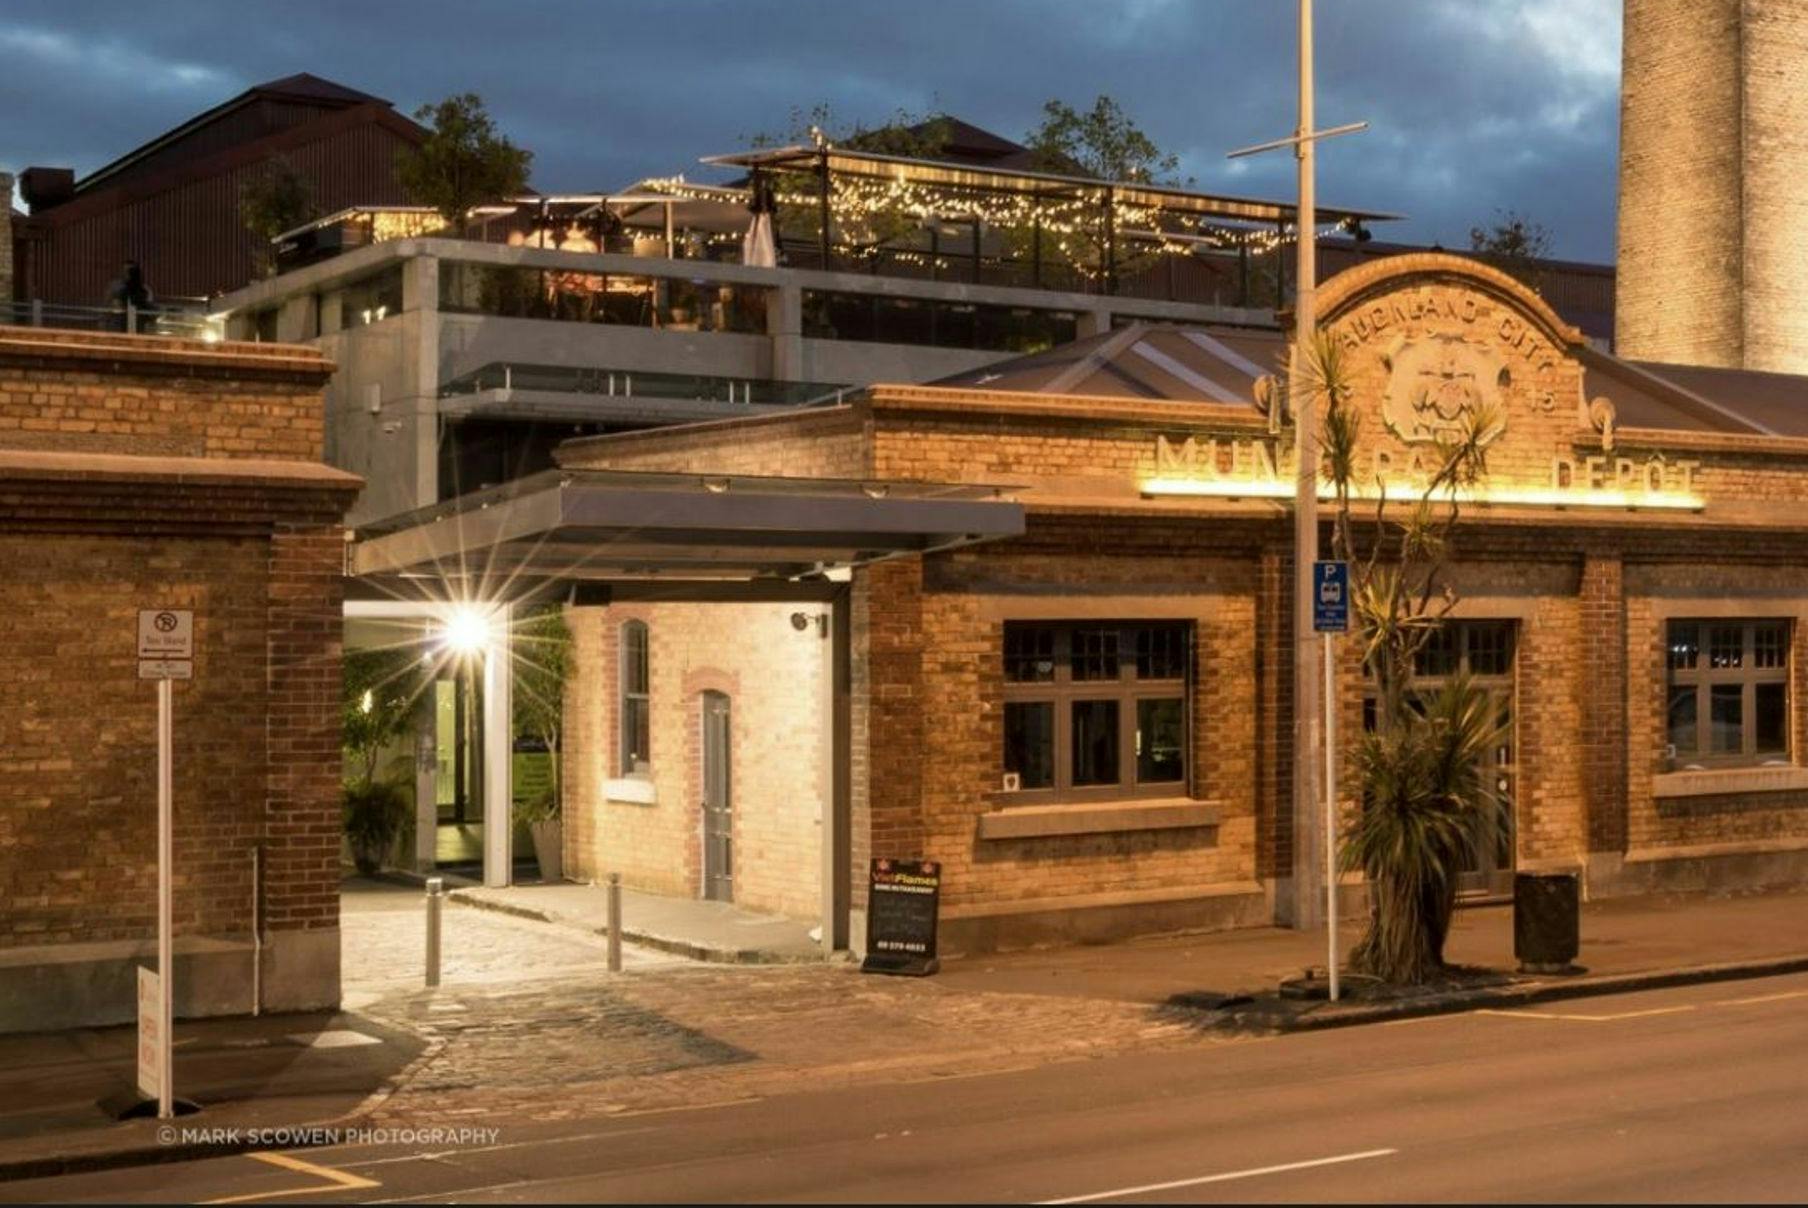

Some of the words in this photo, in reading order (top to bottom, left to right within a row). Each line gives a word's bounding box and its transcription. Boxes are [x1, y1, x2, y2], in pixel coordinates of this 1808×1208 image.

[1338, 297, 1477, 350] AUCKLAND
[1498, 317, 1555, 372] CITY
[1552, 452, 1702, 496] DEPÔT
[1325, 564, 1337, 581] P
